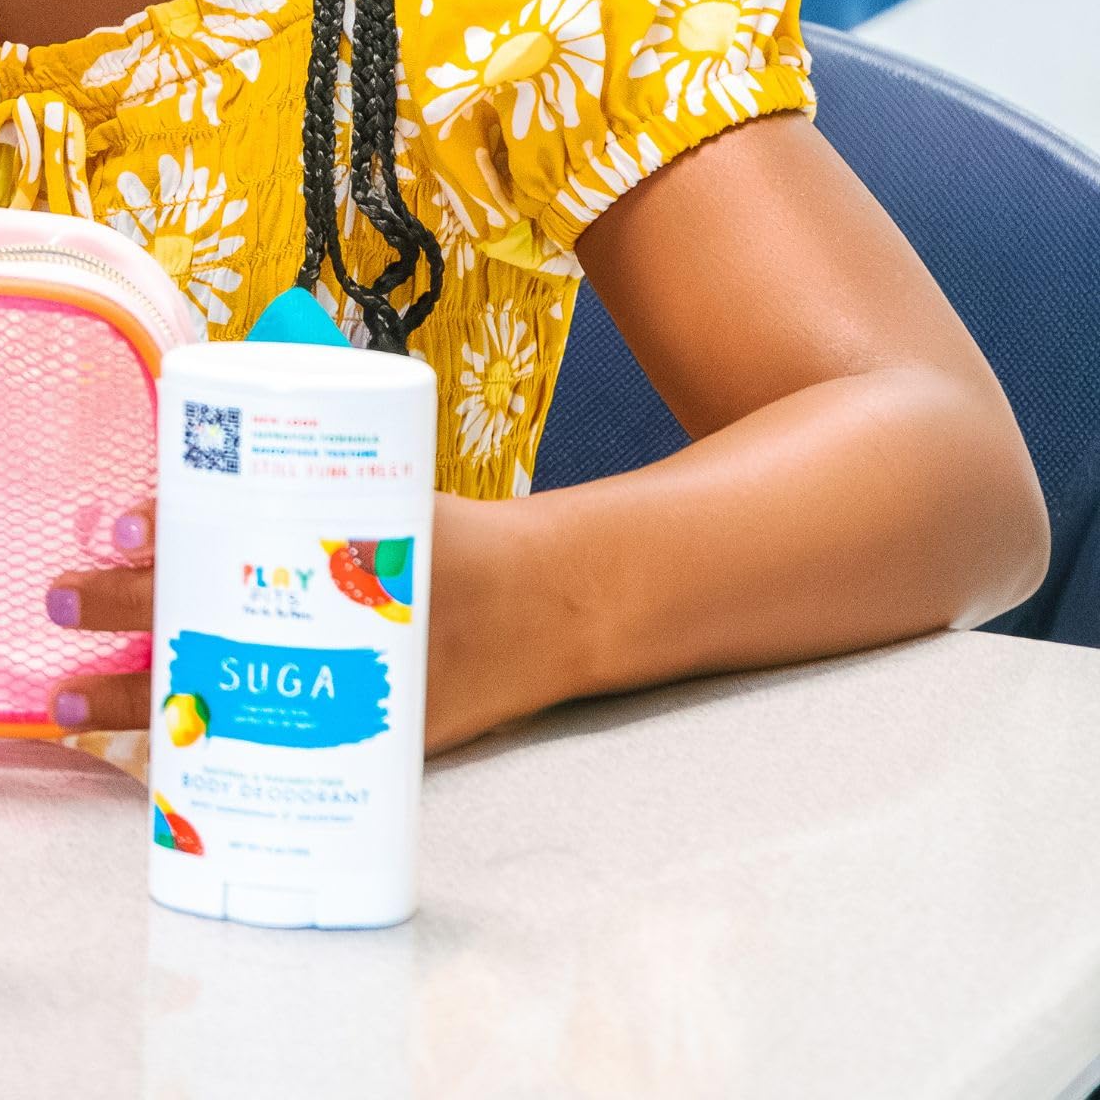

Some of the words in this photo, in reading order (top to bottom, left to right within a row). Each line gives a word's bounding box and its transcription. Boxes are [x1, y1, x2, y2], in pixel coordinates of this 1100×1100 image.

[243, 564, 314, 590] PLAY
[219, 657, 336, 699] SUGA
[182, 772, 231, 793] BODY
[240, 785, 370, 804] DEODORANT
